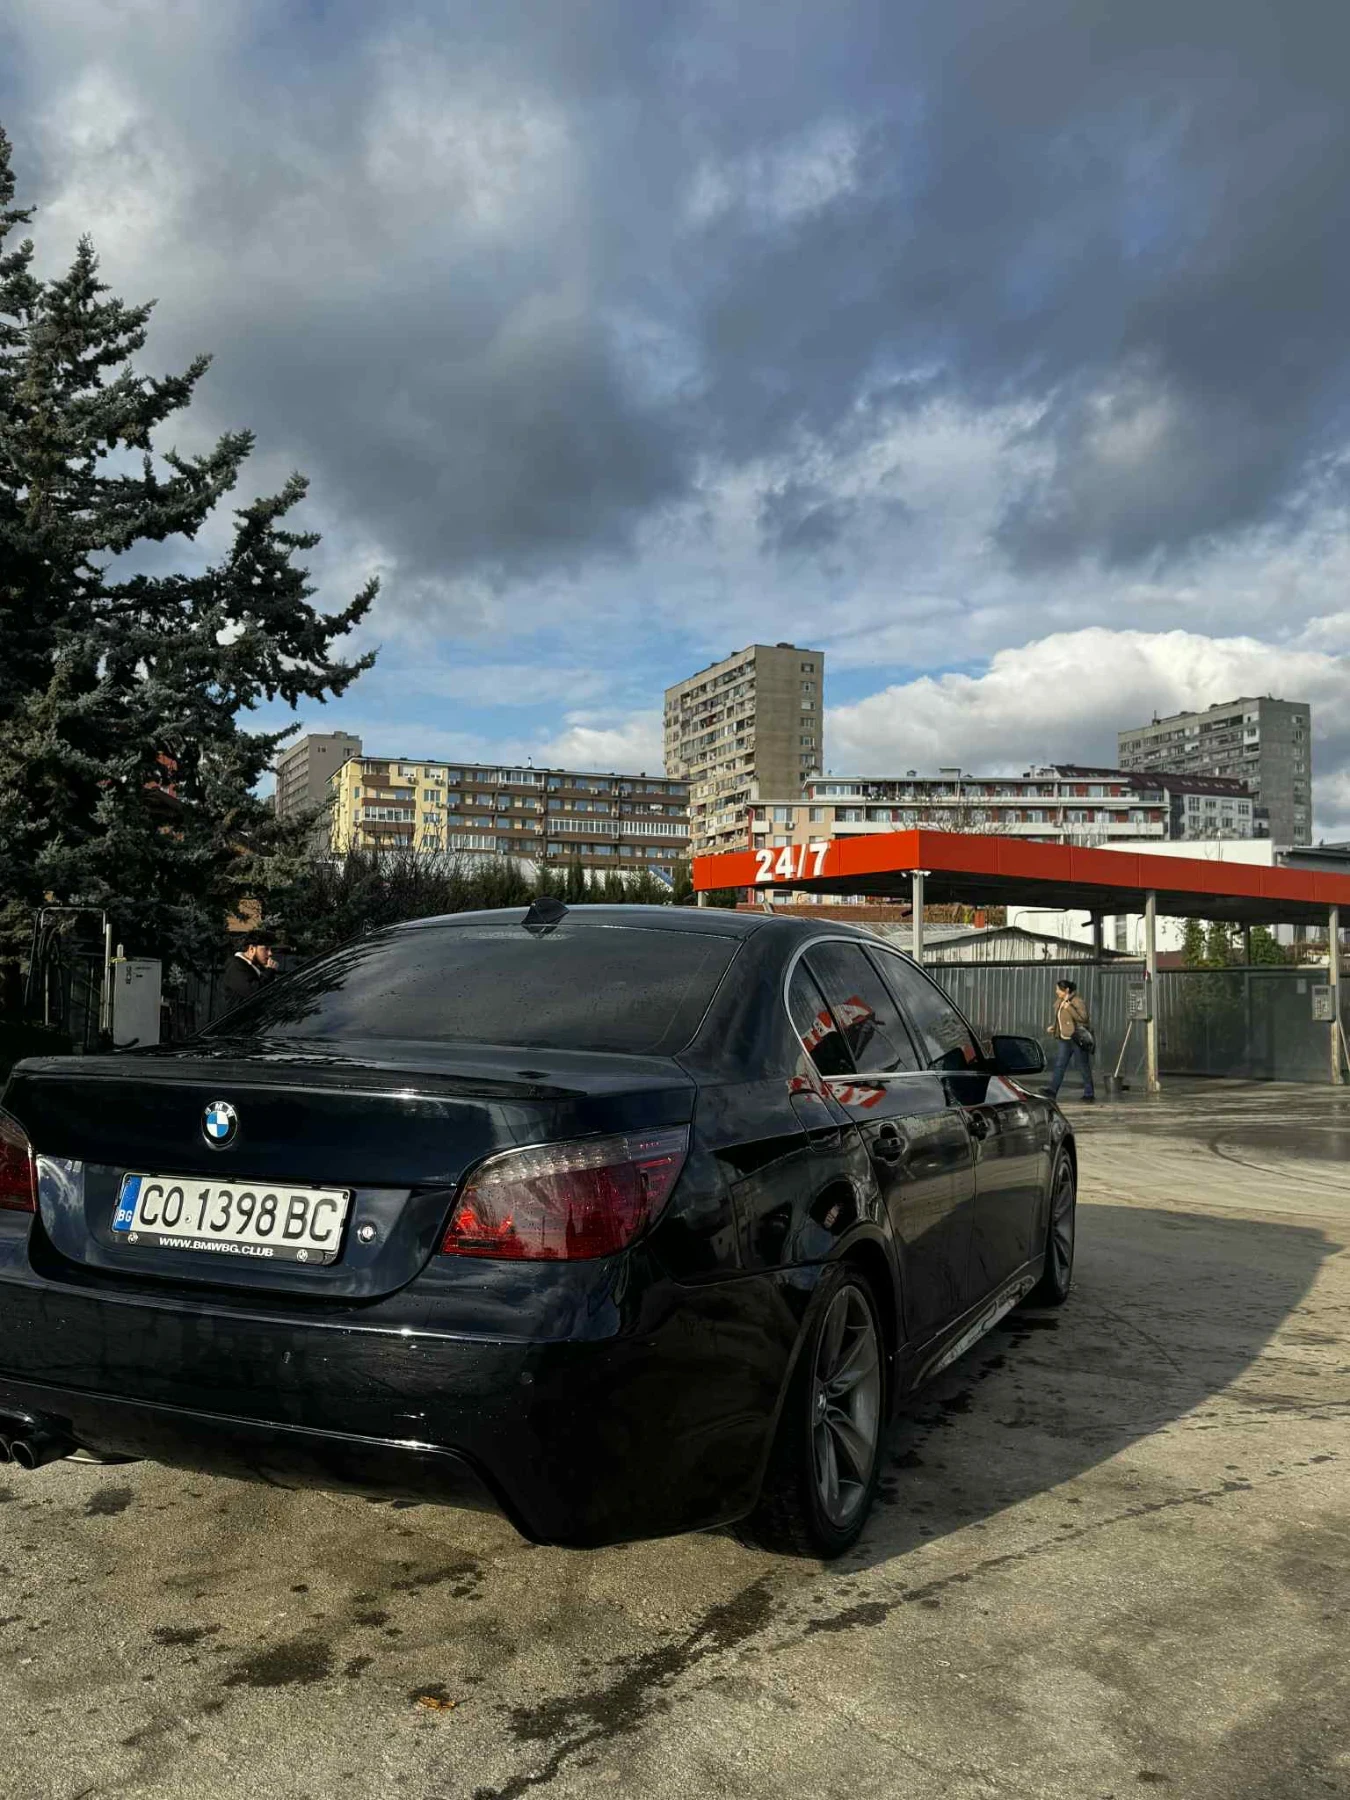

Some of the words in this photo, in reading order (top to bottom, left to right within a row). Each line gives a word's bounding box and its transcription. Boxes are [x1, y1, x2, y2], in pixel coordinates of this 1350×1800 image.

[755, 842, 831, 882] 24/7
[205, 1103, 235, 1118] BMW
[117, 1209, 133, 1222] BG
[159, 1237, 274, 1257] WWW.BMWBG.CLUB
